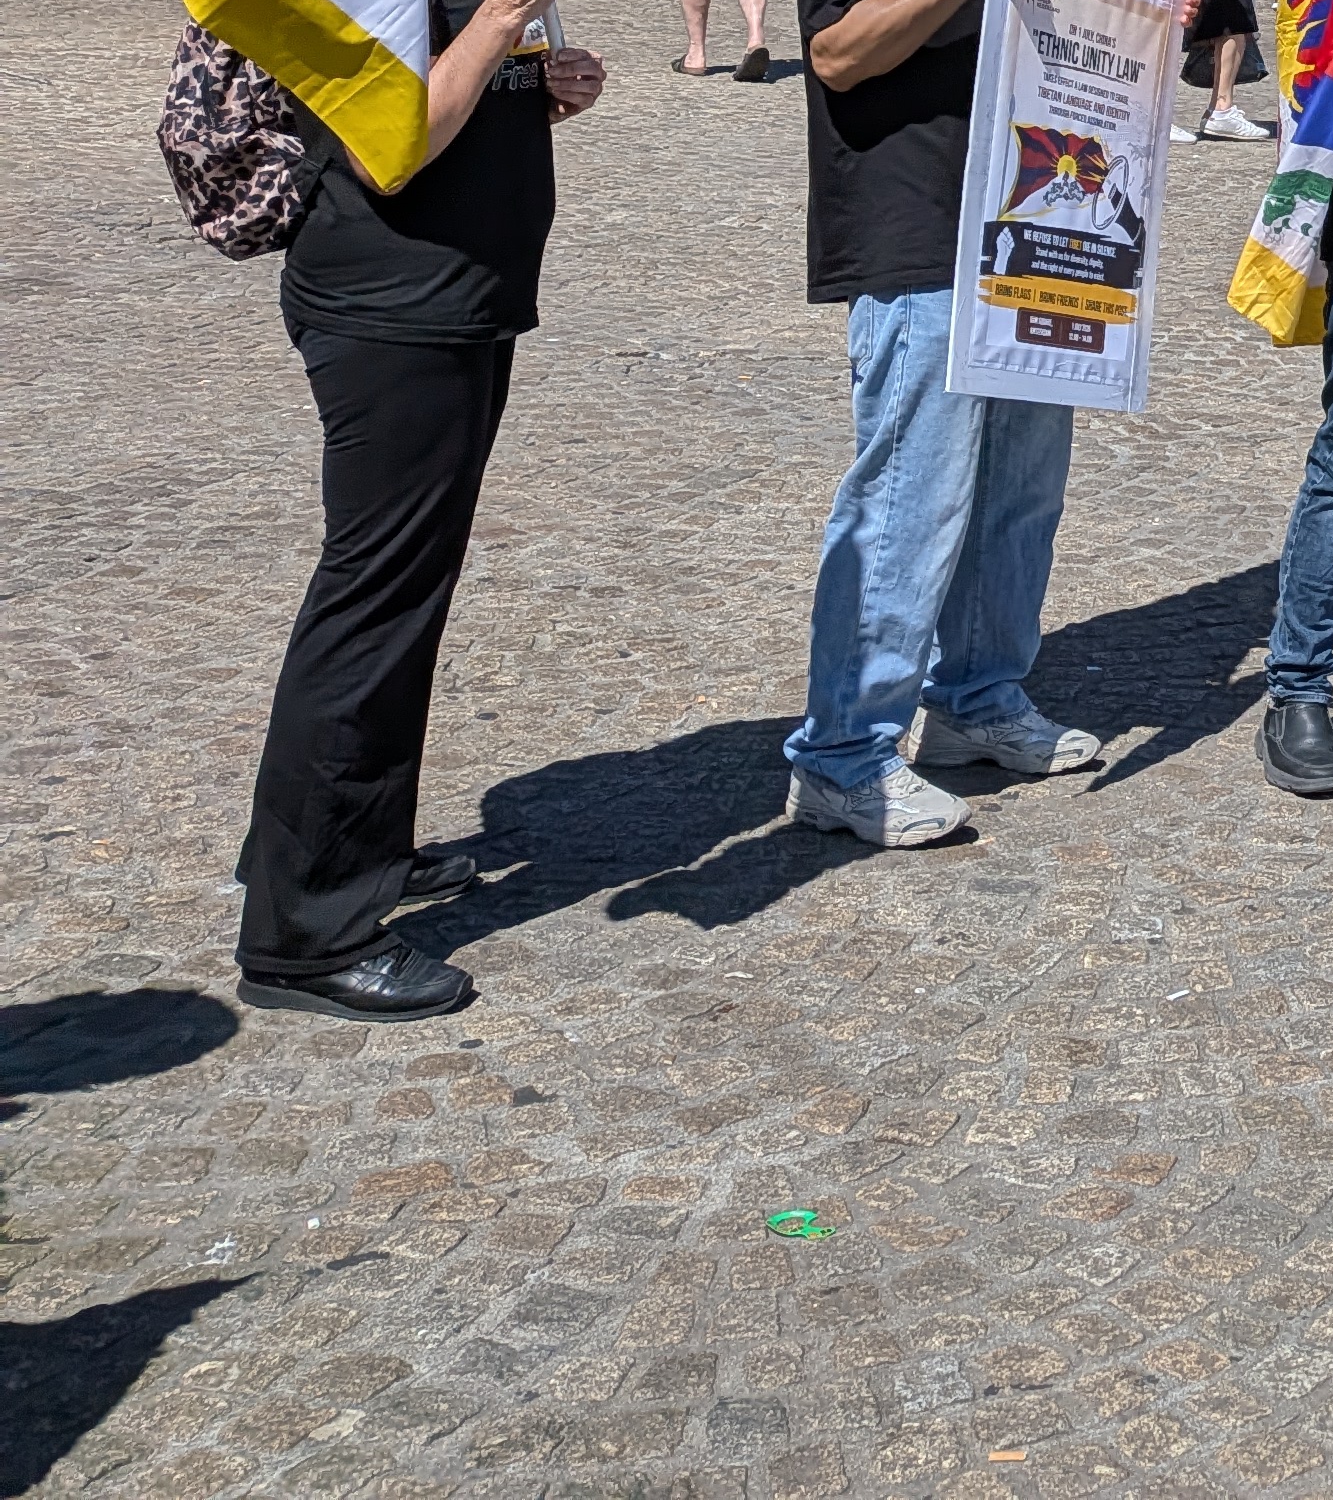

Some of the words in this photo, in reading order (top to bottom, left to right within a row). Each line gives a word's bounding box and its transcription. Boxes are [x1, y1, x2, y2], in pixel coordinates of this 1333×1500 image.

[491, 58, 538, 91] Free
[1031, 29, 1079, 64] "ETHNIC
[1081, 45, 1114, 75] UNITY
[1115, 56, 1145, 85] LAW"
